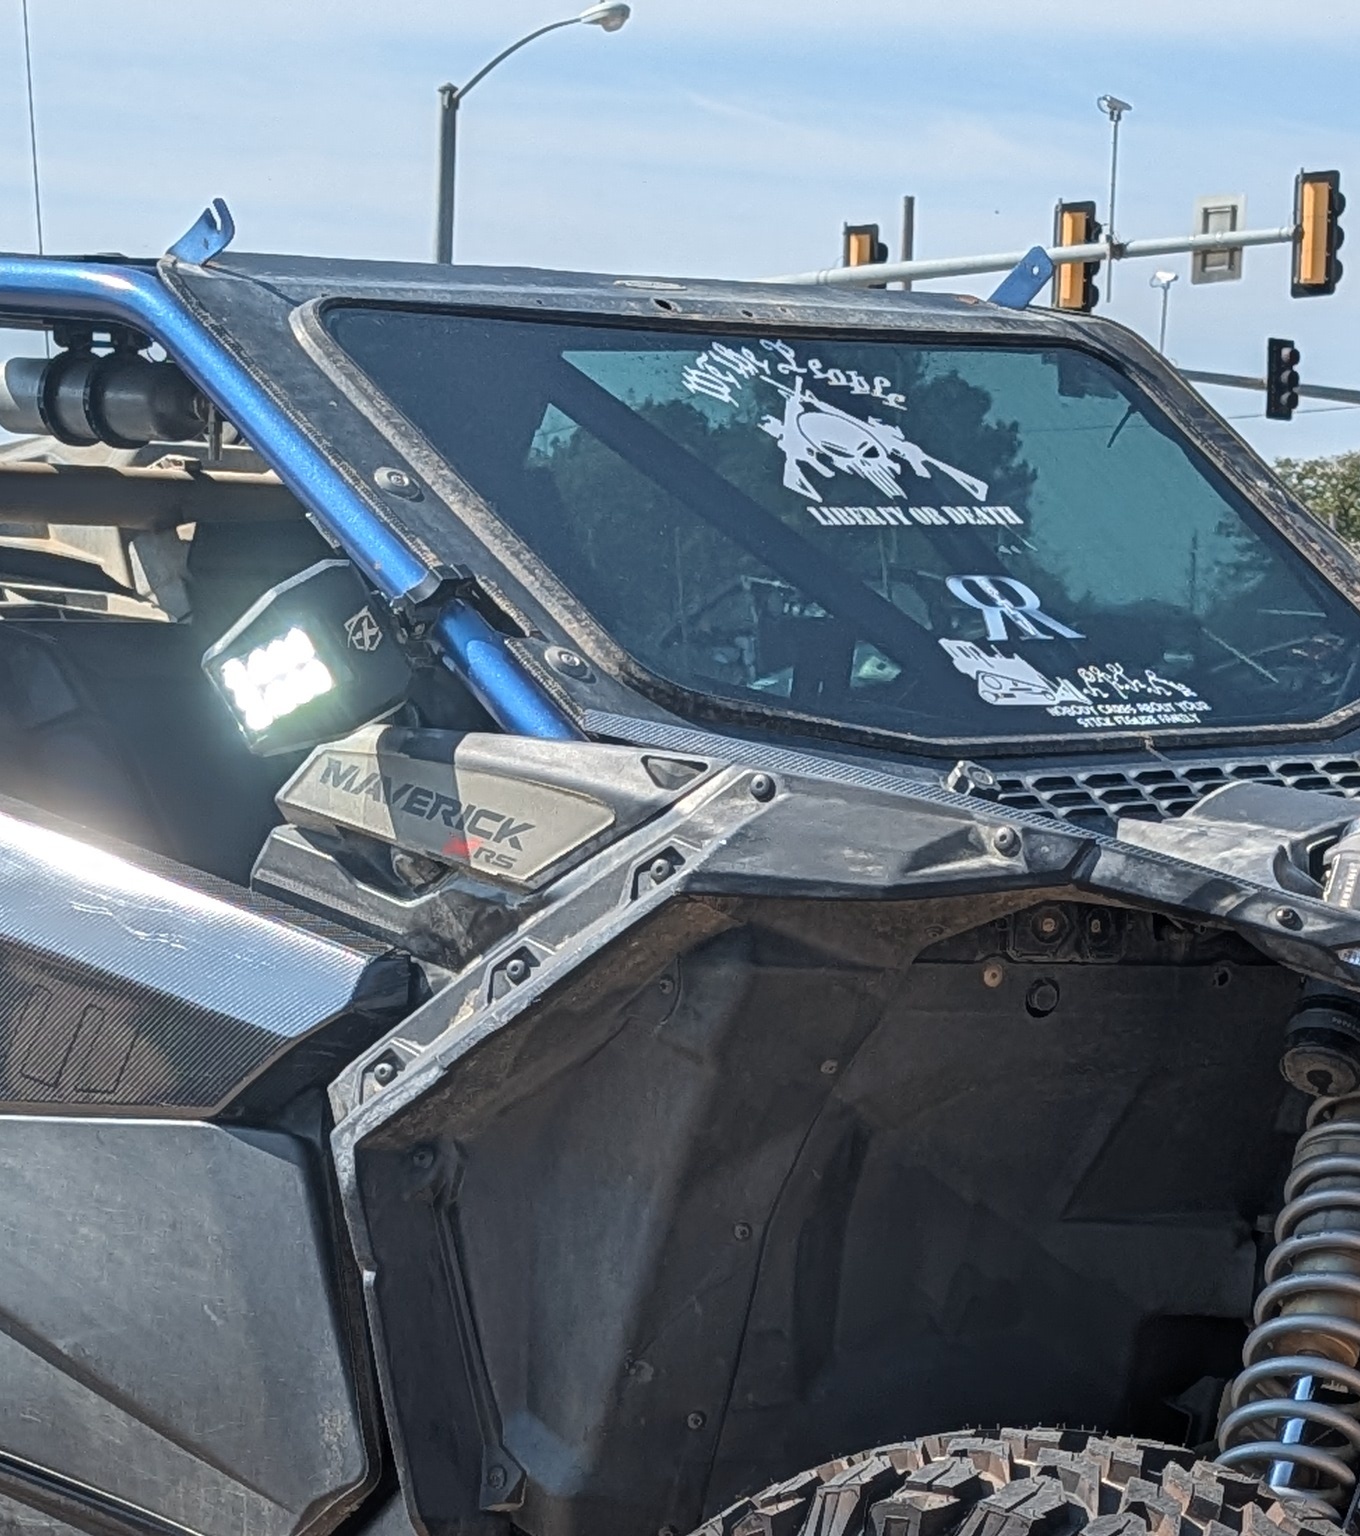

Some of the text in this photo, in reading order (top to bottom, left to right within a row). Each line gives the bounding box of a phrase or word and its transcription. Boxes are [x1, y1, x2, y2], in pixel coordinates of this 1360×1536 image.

[806, 505, 1025, 526] LIBERTY OR DEATH
[1044, 700, 1213, 717] NOBODY CARES ABOUT YOUR
[1076, 711, 1203, 728] STICK FIGURE FAMILY
[319, 757, 537, 852] MAVERICK
[473, 846, 520, 871] RS
